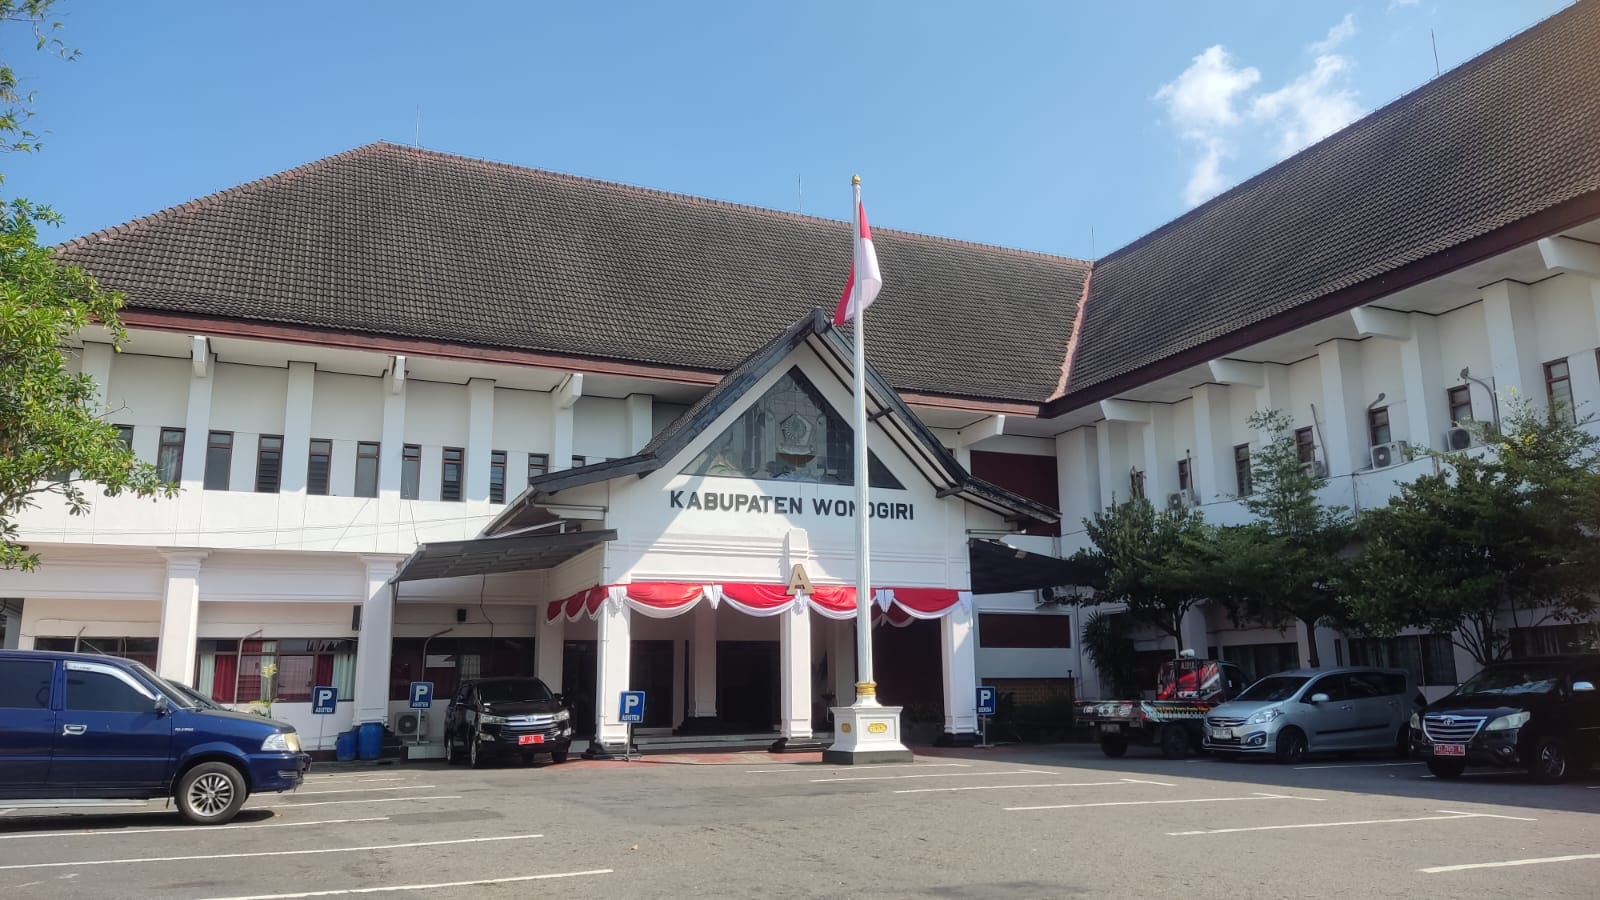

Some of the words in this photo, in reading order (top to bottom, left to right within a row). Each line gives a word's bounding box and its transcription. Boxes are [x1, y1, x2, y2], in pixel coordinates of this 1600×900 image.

[670, 490, 803, 514] KABUPATEN
[785, 564, 814, 595] A
[319, 690, 333, 706] P
[415, 685, 428, 700] P
[981, 690, 991, 706] P
[625, 695, 639, 713] P
